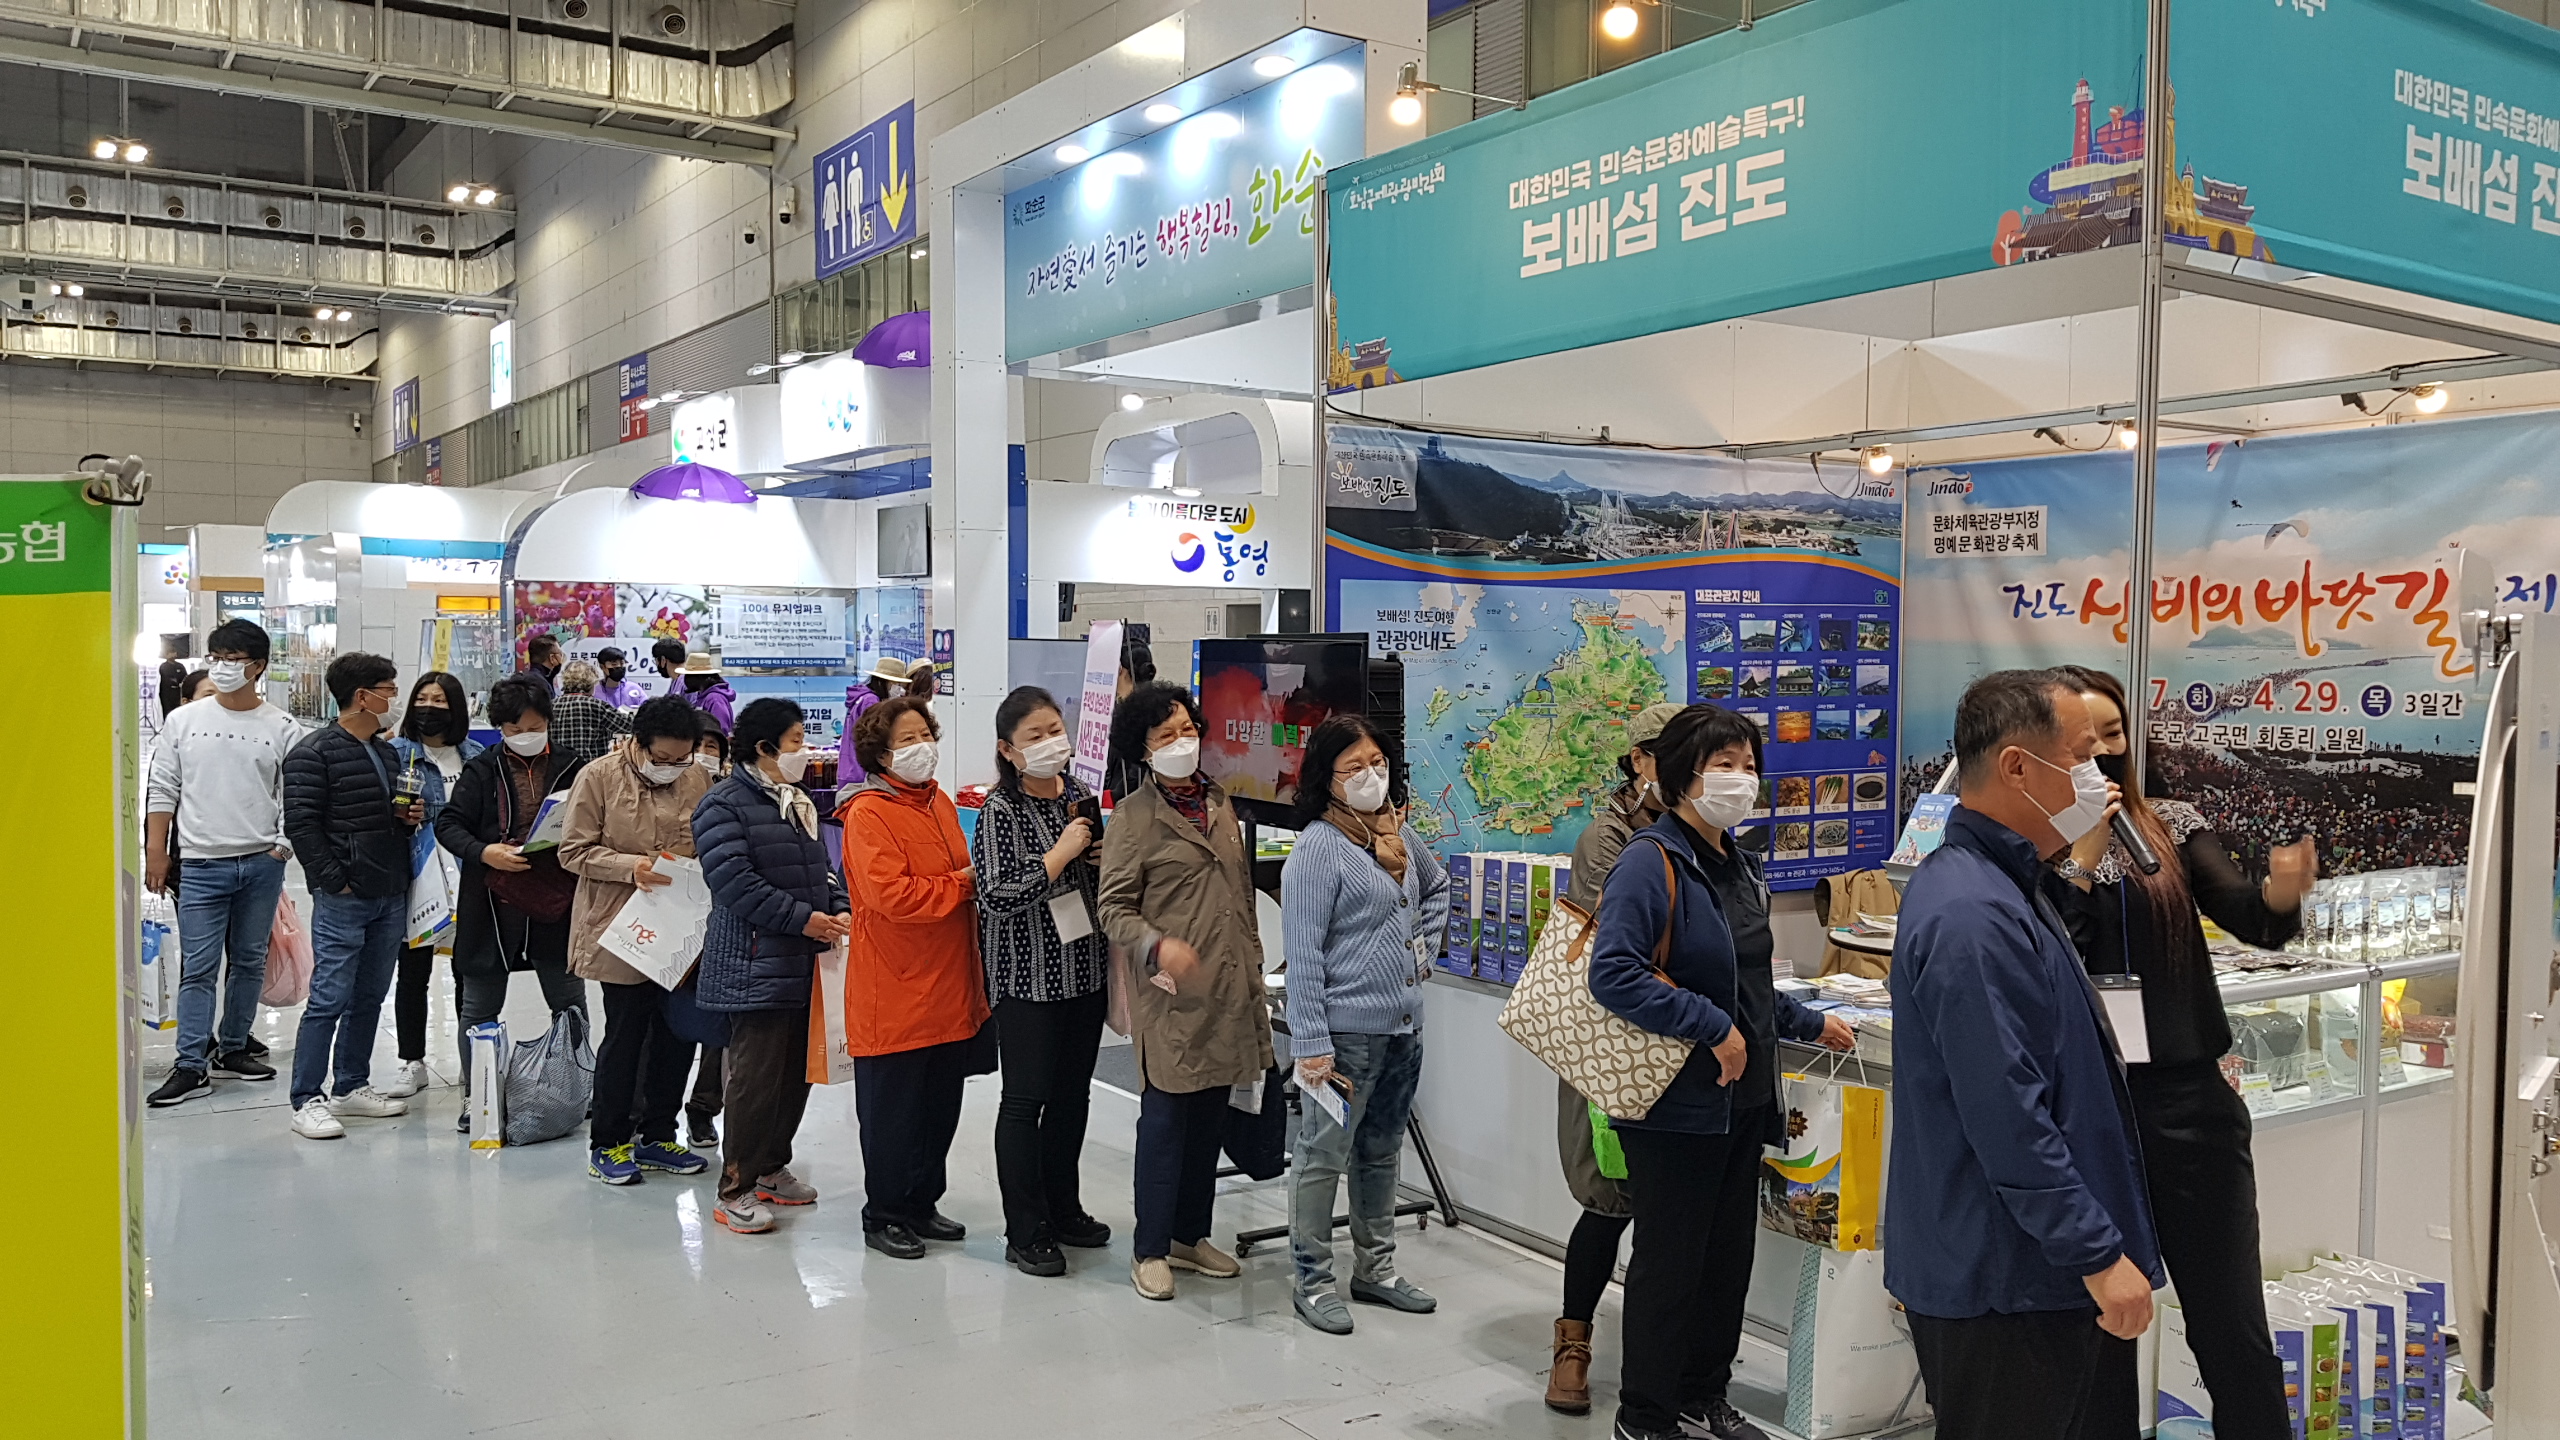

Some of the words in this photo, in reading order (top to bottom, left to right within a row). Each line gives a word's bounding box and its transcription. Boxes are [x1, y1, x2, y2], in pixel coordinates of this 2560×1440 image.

[2395, 69, 2469, 124] 대한민국
[1509, 159, 1592, 210] 대한민국
[1600, 95, 1805, 185] 민속문화예술특구!
[2403, 124, 2519, 224] 보배섬
[1025, 195, 1045, 214] 화순군
[1520, 183, 1658, 279] 보배섬
[1679, 149, 1787, 242] 진도
[1028, 243, 1095, 296] 자연愛서
[1104, 230, 1148, 285] 즐기는
[1341, 477, 1372, 496] 보배섬
[1373, 476, 1410, 504] 진도
[1857, 481, 1889, 498] Jindo
[1927, 480, 1965, 497] Jindo
[1219, 506, 1247, 525] 도시
[1932, 510, 2040, 533] 문화체육관광부지정
[1214, 531, 1269, 582] 통영
[742, 603, 769, 614] 1004
[772, 603, 823, 615] 뮤지엄파크
[1695, 589, 1740, 603] 대표관광지
[1742, 590, 1761, 604] 안내
[1376, 609, 1411, 624] 보배섬!
[1413, 609, 1456, 625] 진도여행
[2002, 582, 2075, 619] 진도
[2254, 559, 2474, 677] 바닷길
[2494, 573, 2558, 614] 제
[1376, 630, 1457, 651] 관광안내도
[2150, 679, 2176, 710] 7.
[2190, 682, 2209, 710] 화
[2366, 687, 2388, 714] 목
[2404, 692, 2464, 718] 3일간
[1225, 719, 1266, 746] 다양한
[2150, 721, 2185, 745] 도군
[2193, 724, 2249, 748] 고군면
[2258, 726, 2316, 750] 회동리
[2325, 728, 2366, 752] 일원
